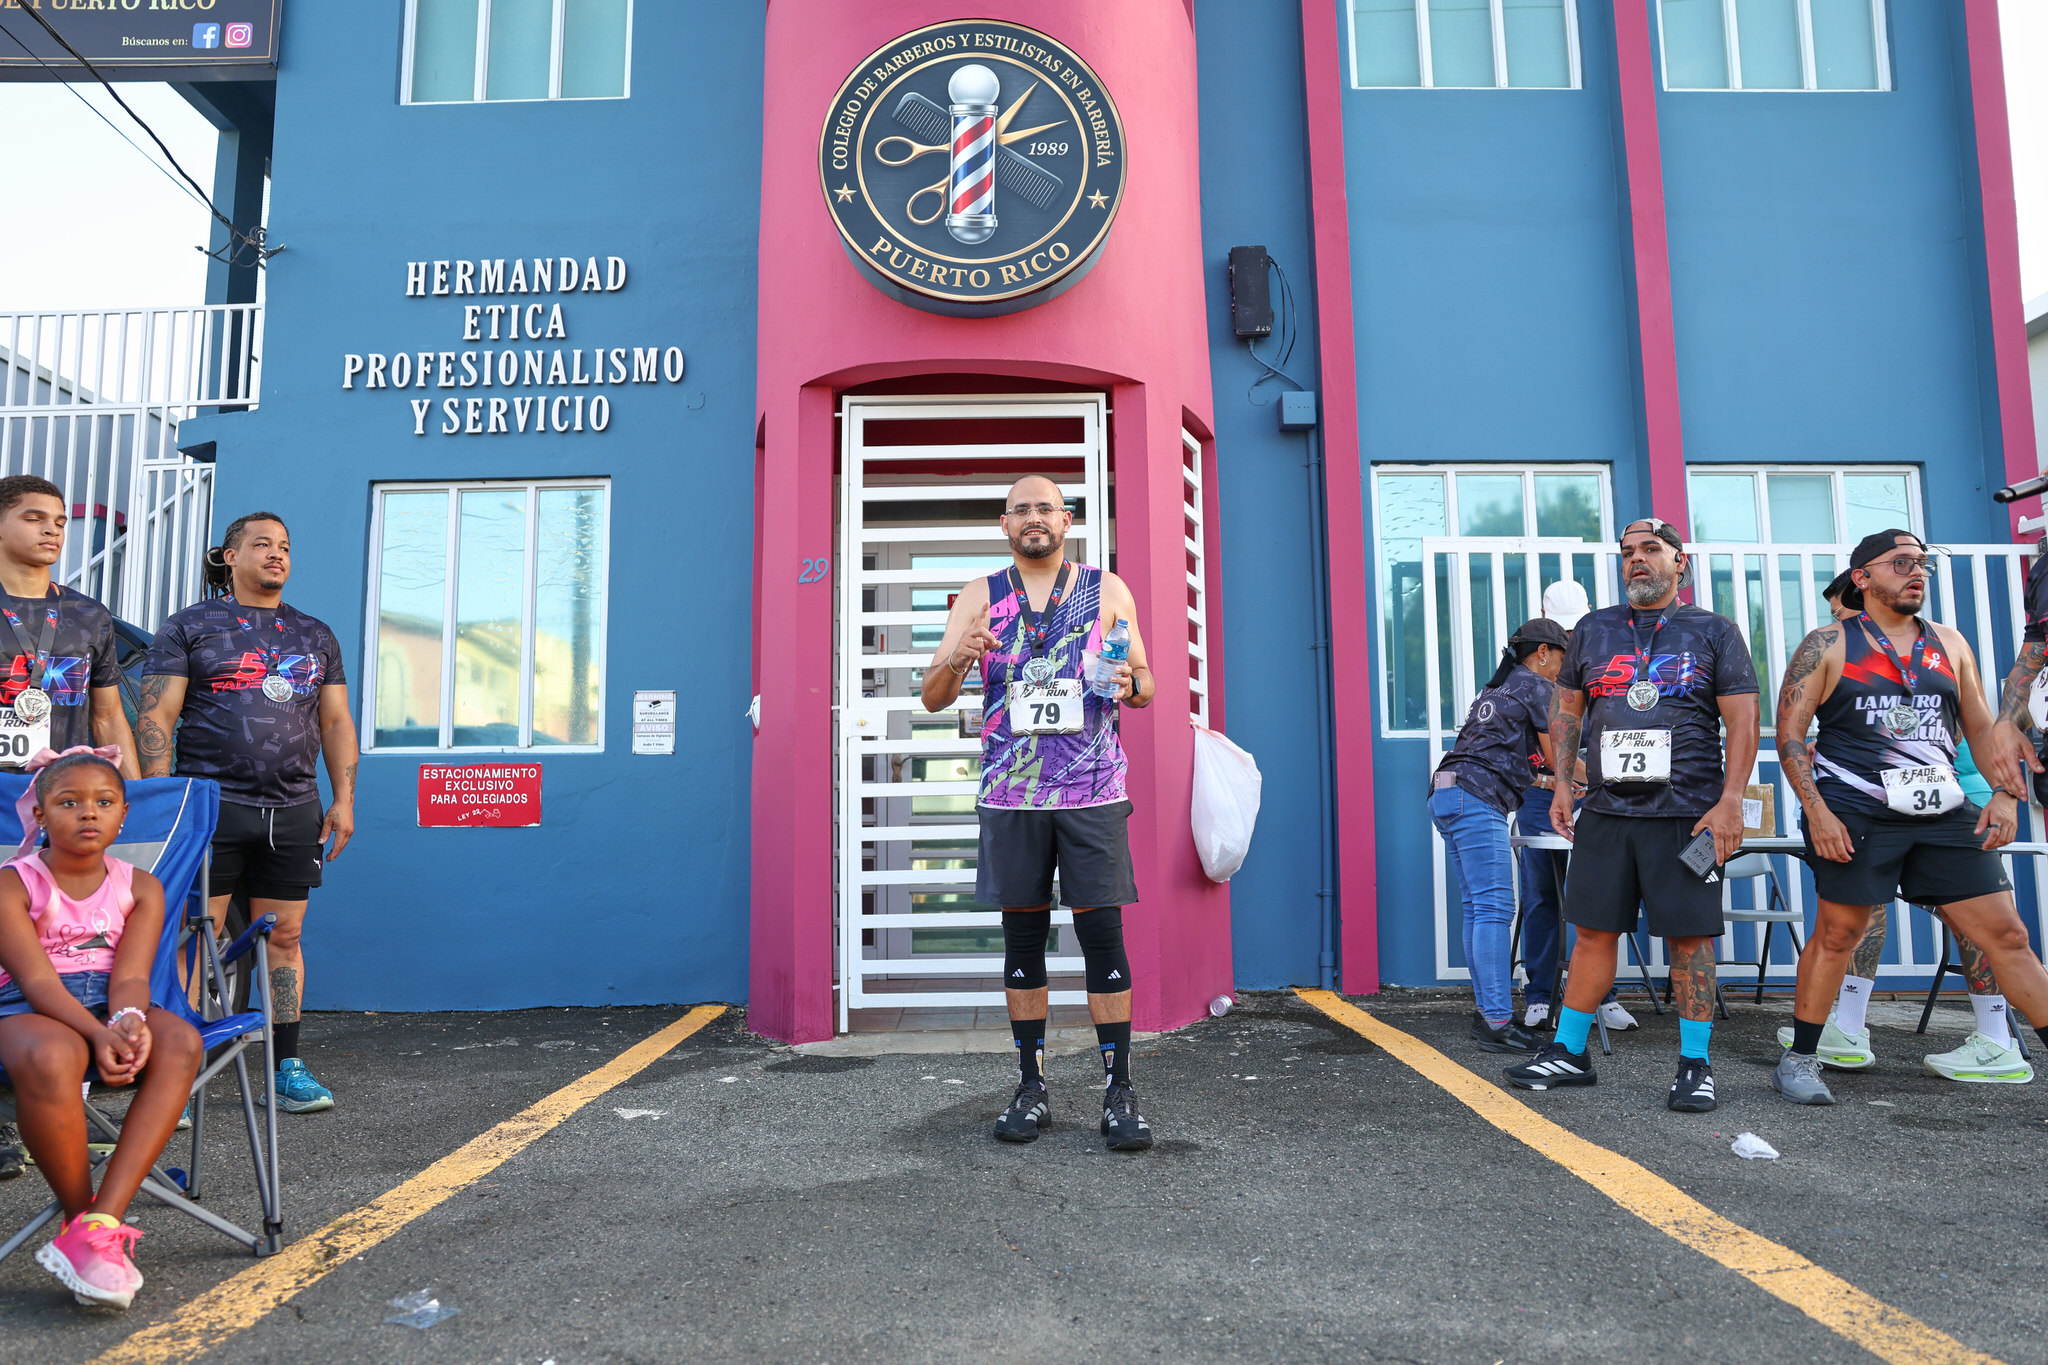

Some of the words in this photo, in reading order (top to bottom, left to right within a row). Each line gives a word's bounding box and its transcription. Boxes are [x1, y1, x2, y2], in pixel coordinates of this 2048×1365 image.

[122, 36, 170, 46] Búscanos
[172, 38, 188, 46] en:
[832, 99, 862, 170] COLEGIO
[854, 77, 878, 100] DE
[873, 35, 956, 82] BARBEROS
[959, 34, 972, 47] Y
[974, 33, 1063, 72] ESTILISTAS
[1059, 67, 1083, 90] EN
[1028, 142, 1069, 156] 1989
[869, 236, 991, 288] PUERTO
[998, 242, 1070, 285] RICO
[405, 256, 628, 296] HERMANDAD
[462, 302, 567, 340] ETICA
[342, 346, 685, 388] PROFESIONALISMO
[411, 399, 431, 435] Y
[442, 395, 611, 435] SERVICIO
[798, 558, 829, 584] 29
[1046, 689, 1068, 697] RUN
[1030, 702, 1061, 725] 79
[639, 724, 669, 732] AVISO
[1621, 732, 1647, 741] FADE
[1619, 752, 1647, 773] 73
[423, 768, 537, 779] ESTACIONAMIENTO
[1911, 767, 1936, 777] FADE
[445, 780, 514, 791] EXCLUSIVO
[1926, 775, 1946, 784] RUN
[430, 794, 458, 804] PARA
[462, 793, 528, 804] COLEGIADOS
[1912, 789, 1942, 811] 34
[457, 812, 470, 821] LEY
[472, 808, 481, 816] 22
